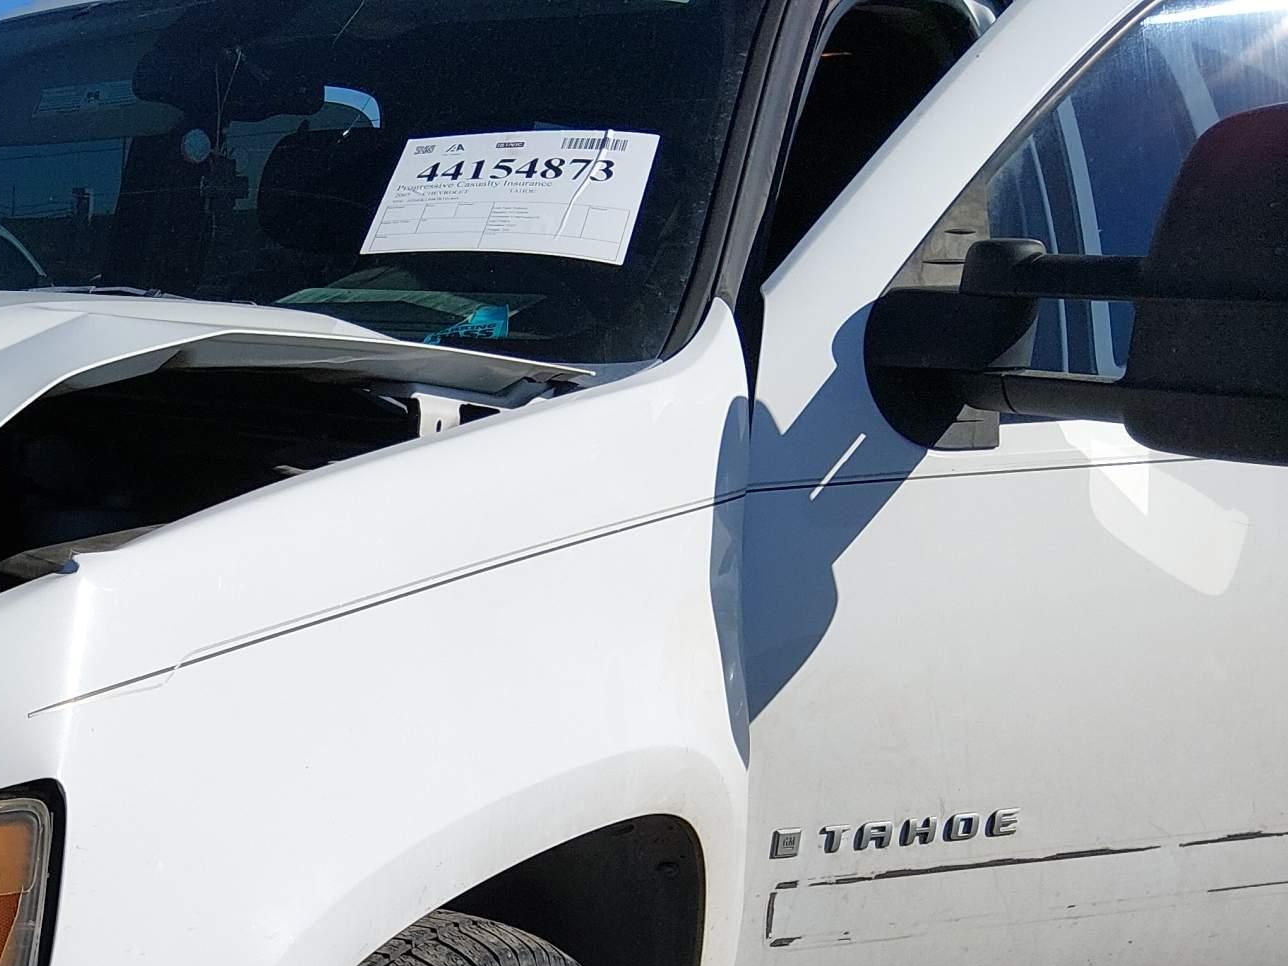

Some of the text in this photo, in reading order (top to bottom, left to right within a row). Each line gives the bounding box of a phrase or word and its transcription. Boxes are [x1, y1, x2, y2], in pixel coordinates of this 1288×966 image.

[416, 157, 616, 182] 44154873
[396, 179, 553, 192] Progressive Casualty Insurance
[818, 807, 1022, 854] TAHOE
